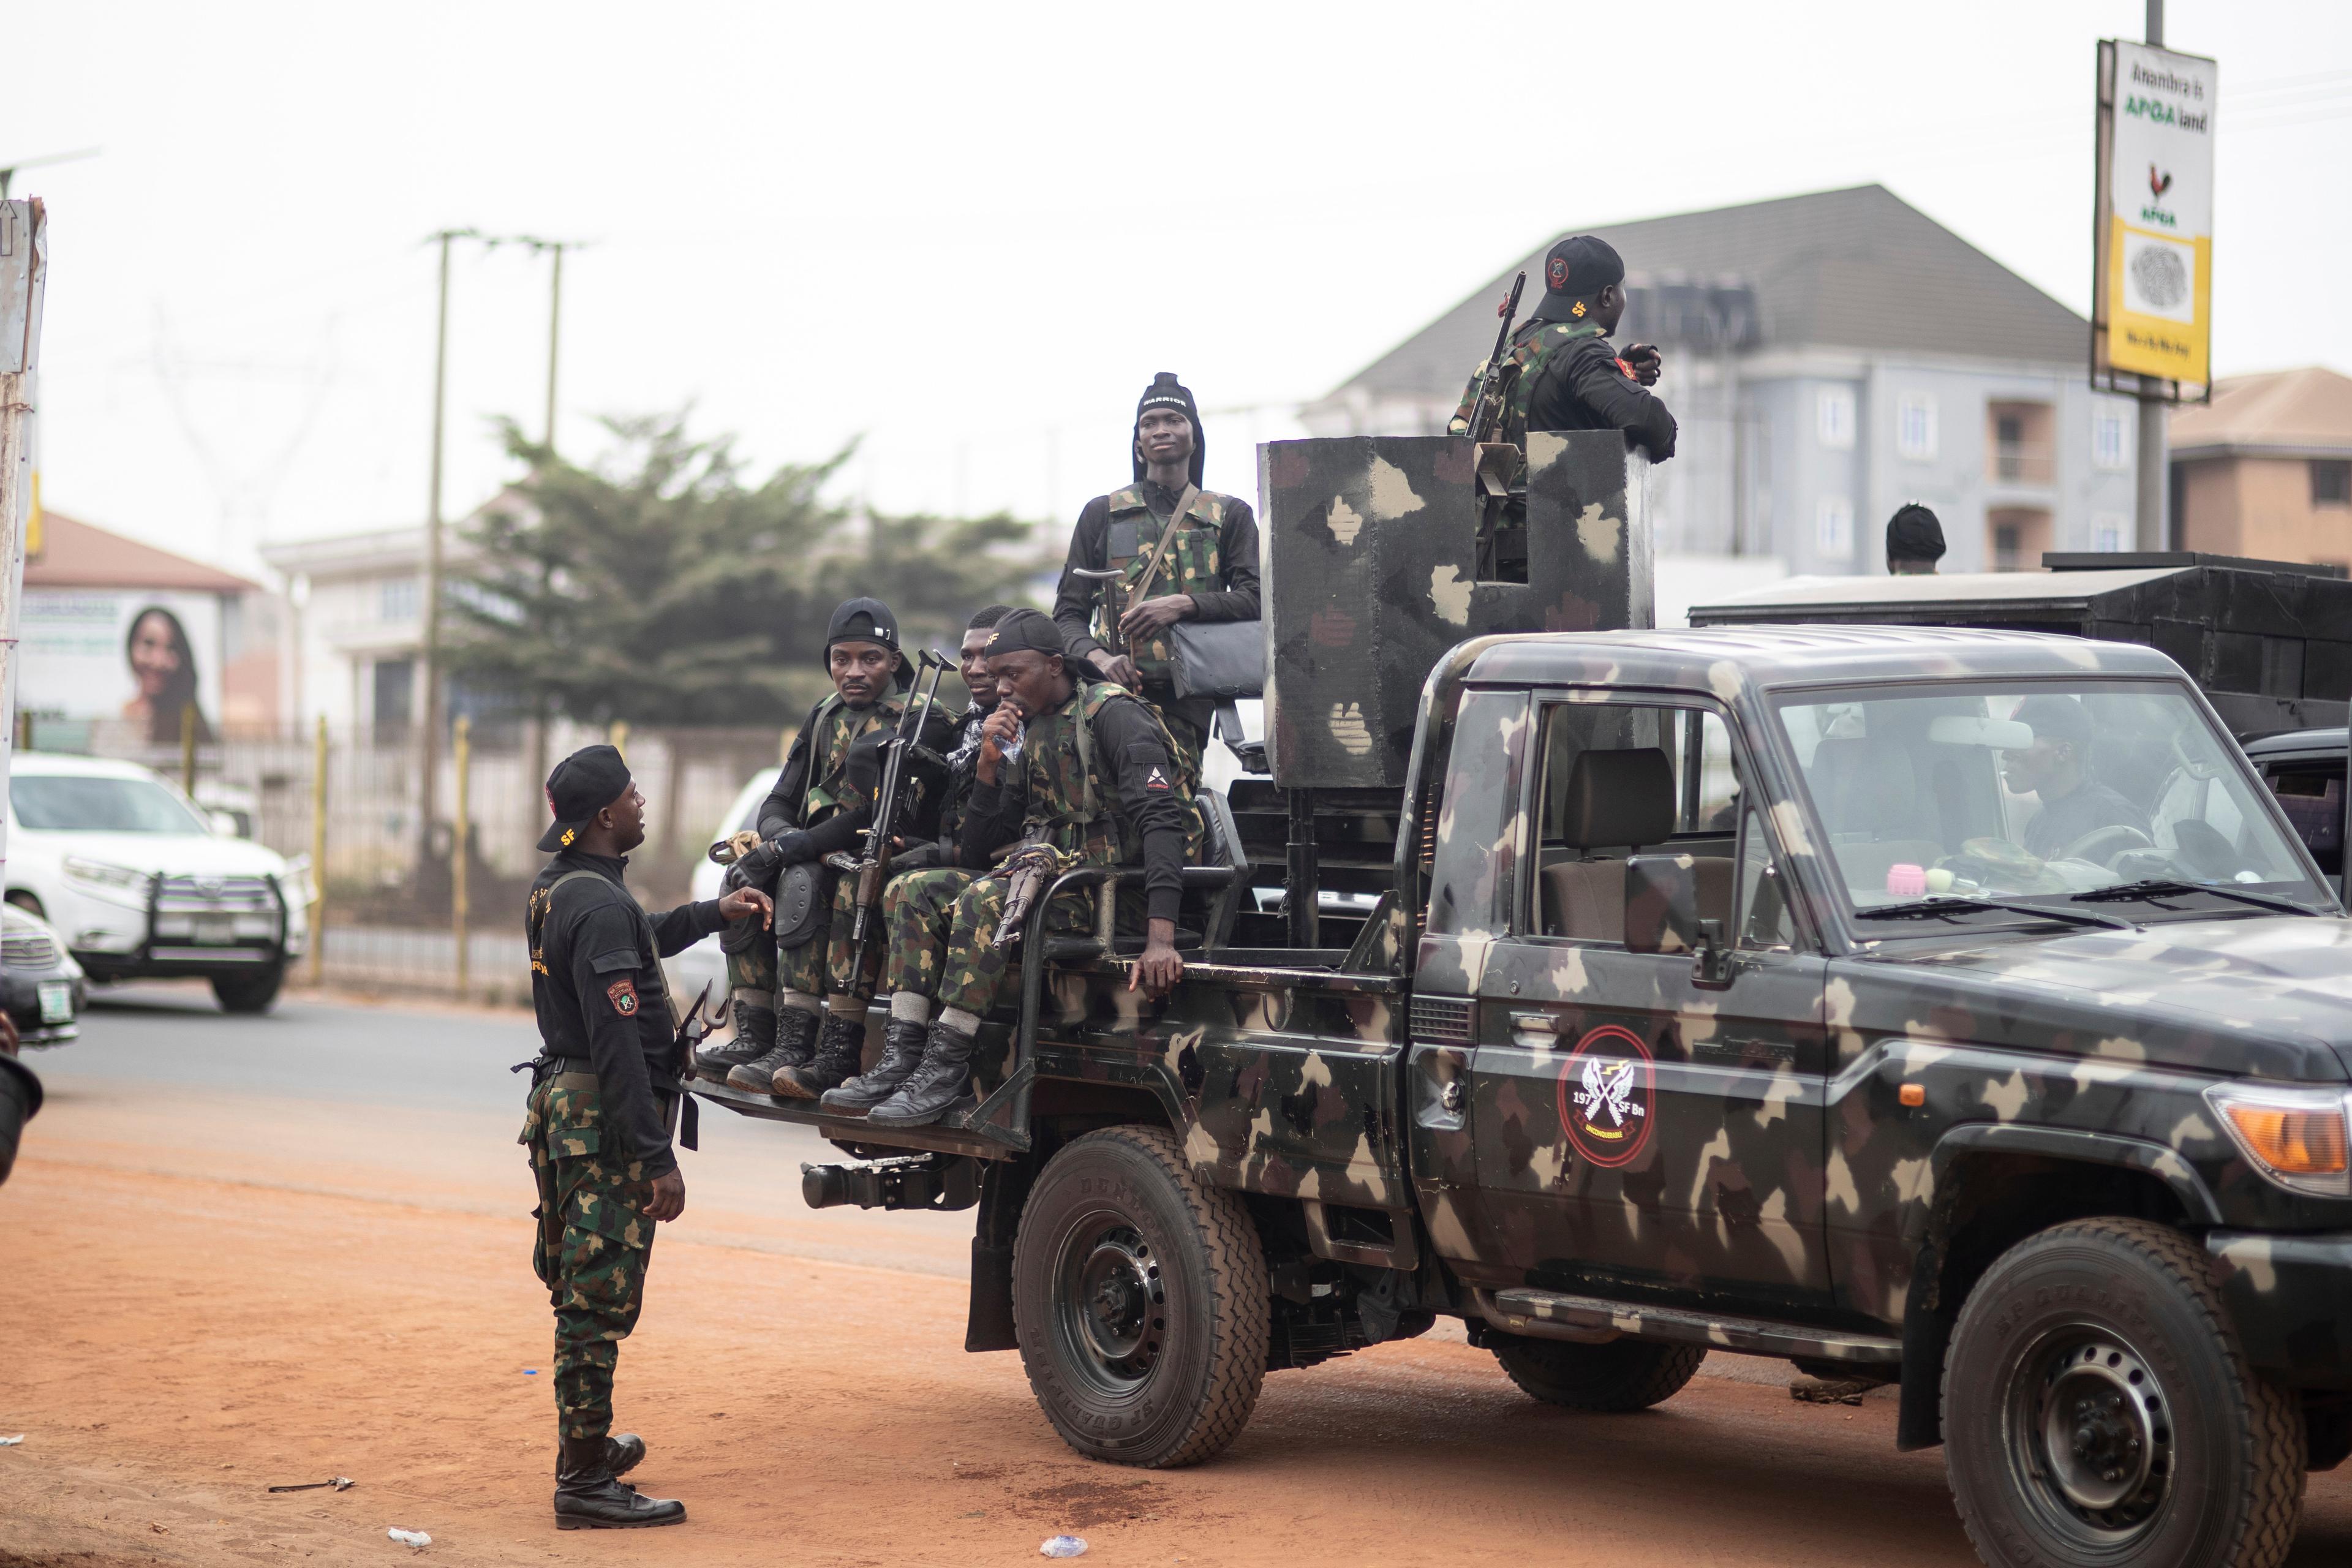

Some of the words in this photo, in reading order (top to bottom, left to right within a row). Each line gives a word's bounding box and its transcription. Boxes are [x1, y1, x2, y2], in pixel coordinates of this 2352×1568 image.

[2132, 63, 2190, 97] Anambra
[2193, 77, 2204, 100] is
[2126, 94, 2175, 124] APGA
[2179, 105, 2207, 134] land
[1572, 301, 1586, 317] SF
[1143, 397, 1186, 407] WARRIOR
[560, 828, 575, 846] SF
[1574, 1091, 1591, 1105] 197
[1618, 1101, 1630, 1114] SF
[1632, 1103, 1645, 1117] Bn
[1585, 1123, 1623, 1139] UNCONQUERABLE
[1131, 1398, 1153, 1426] SP
